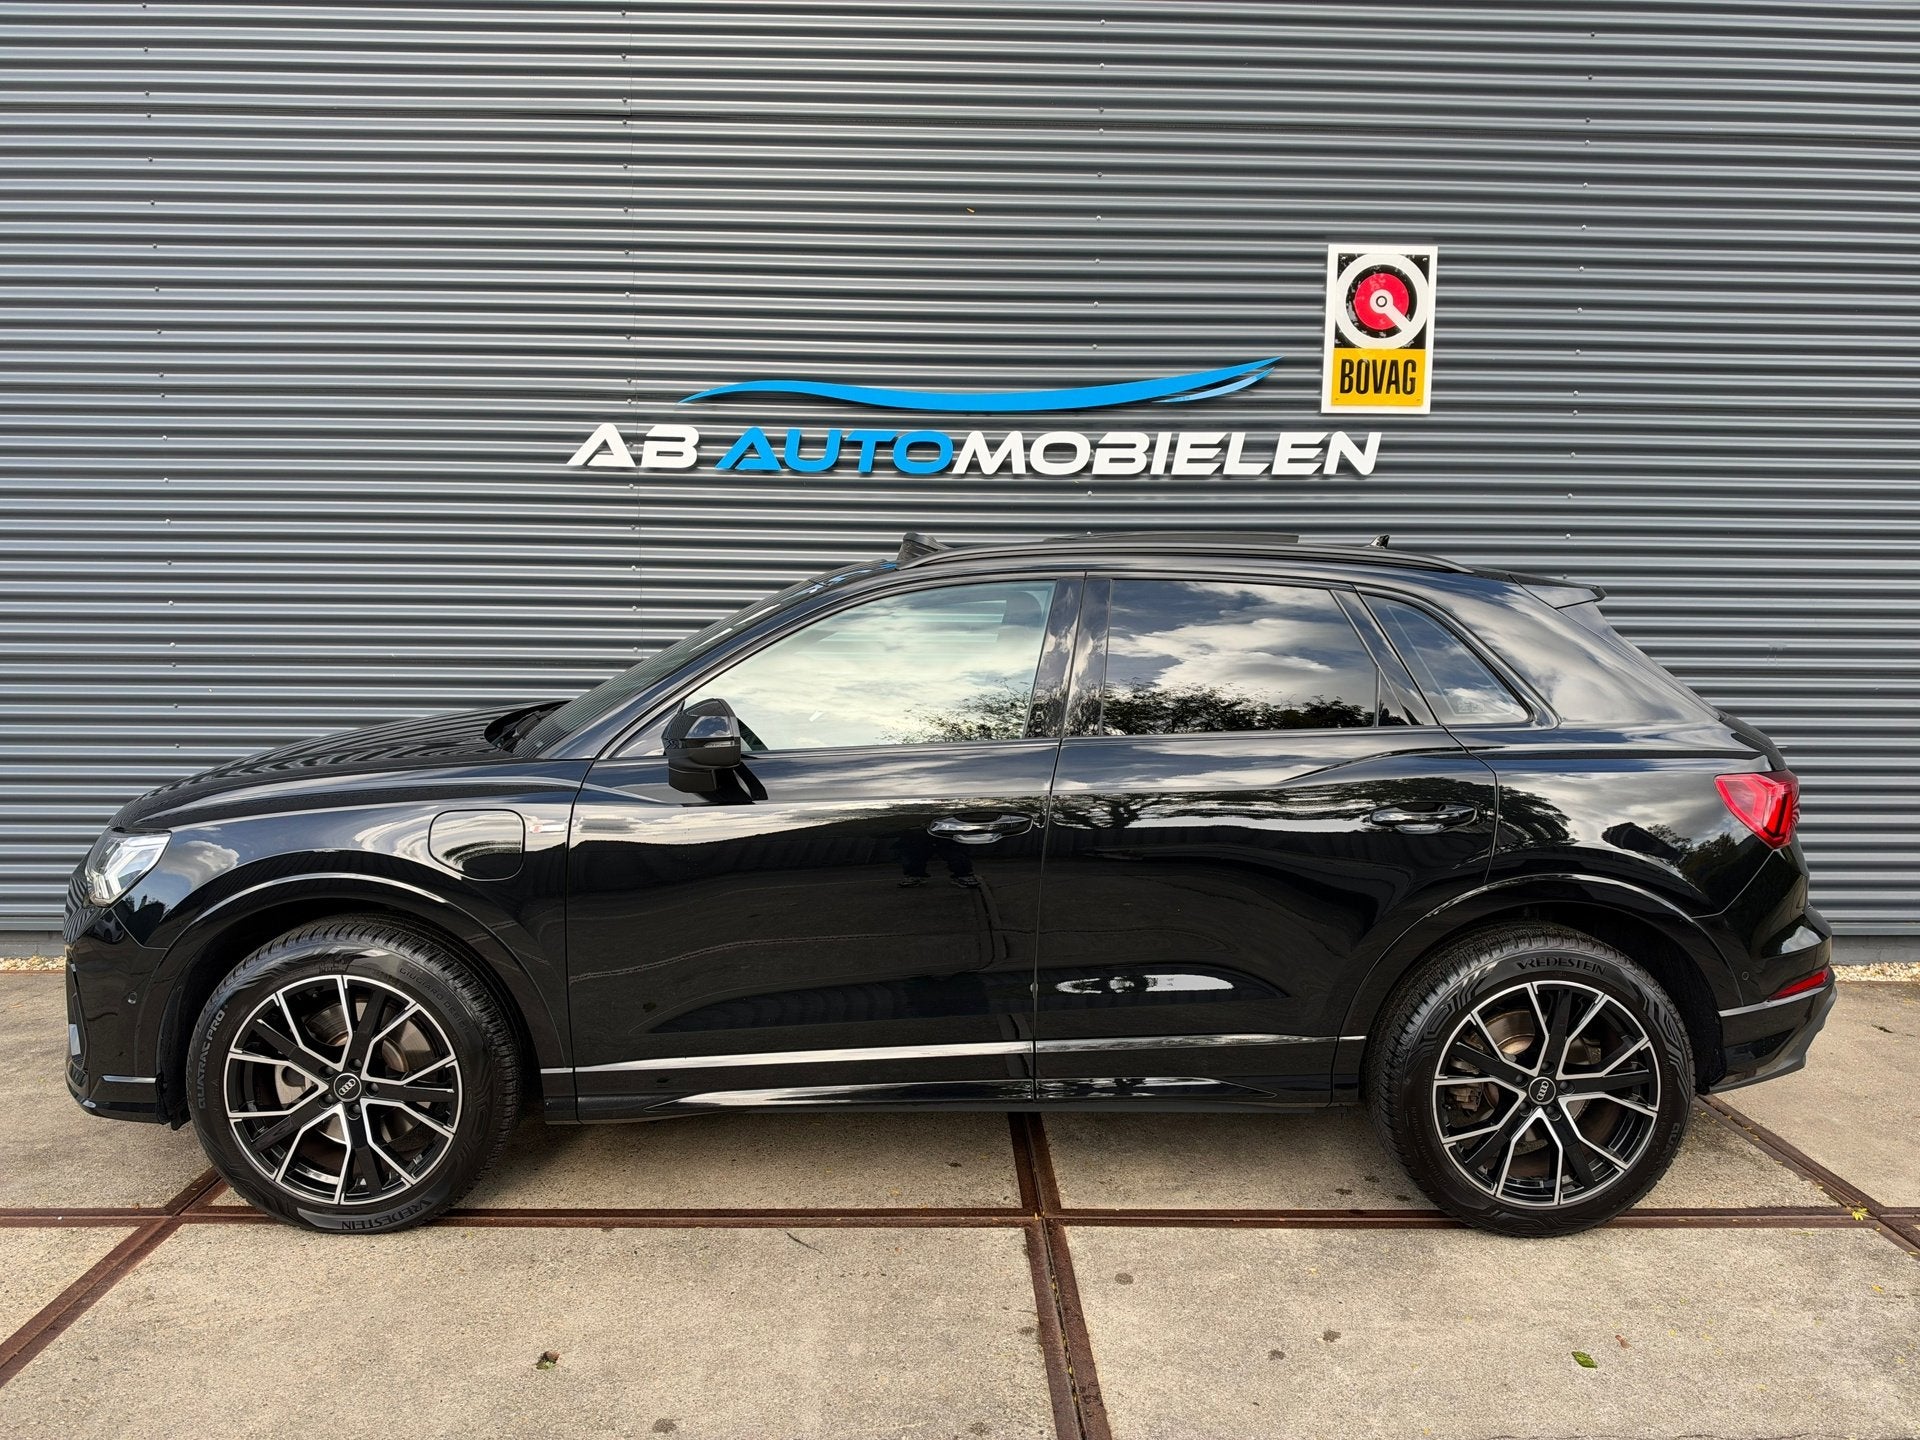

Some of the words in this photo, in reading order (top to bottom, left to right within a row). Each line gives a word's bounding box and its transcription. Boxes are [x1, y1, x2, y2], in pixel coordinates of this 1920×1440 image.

[1339, 358, 1417, 396] BOVAG
[567, 423, 699, 469] AB
[716, 427, 1383, 477] AUTOMOBIELEN
[1516, 956, 1607, 976] VREDESTEIN
[196, 1041, 211, 1109] QUATRAC
[341, 1200, 433, 1230] VREDESTEIN
